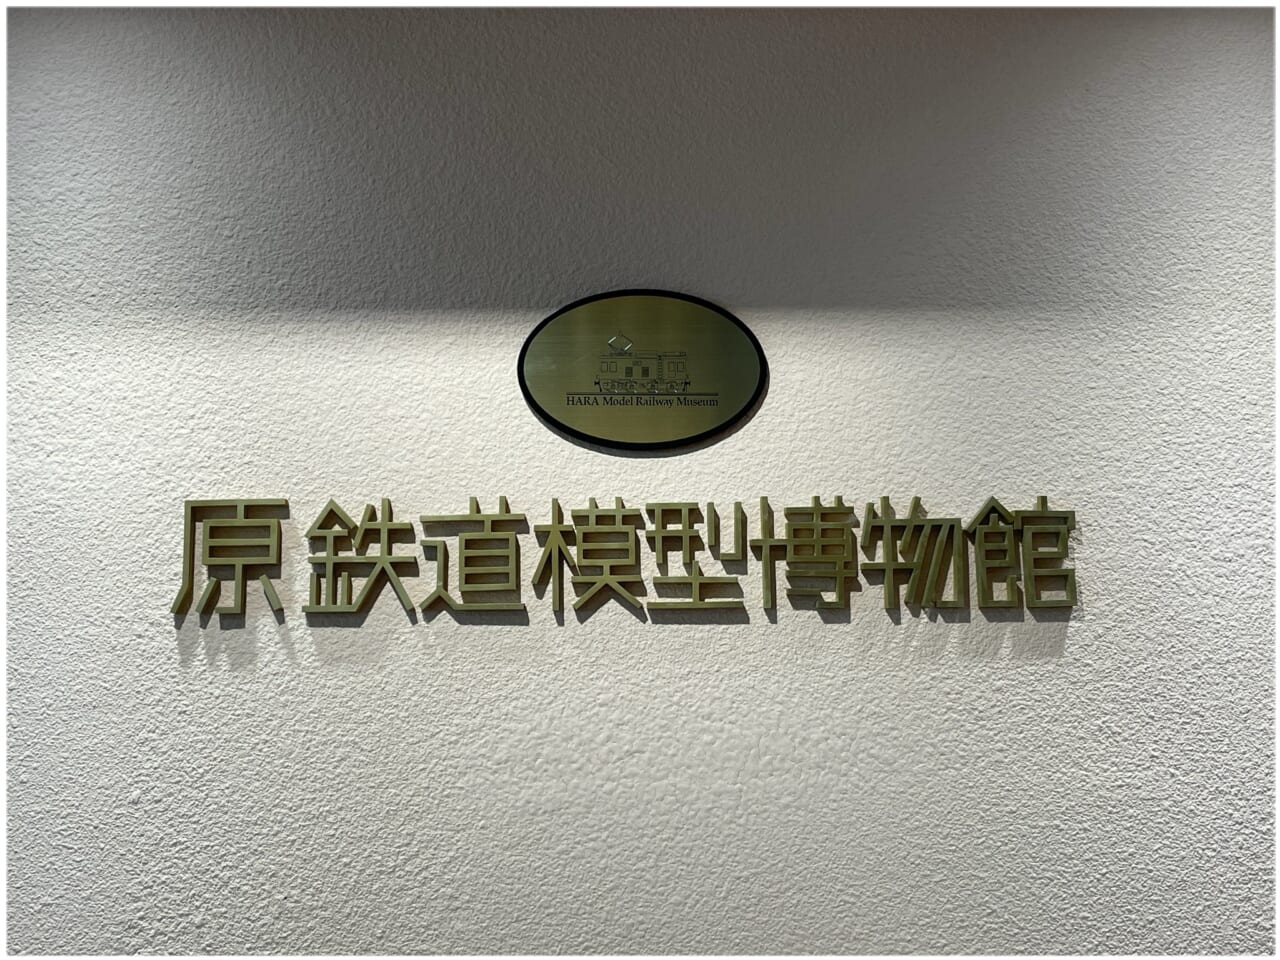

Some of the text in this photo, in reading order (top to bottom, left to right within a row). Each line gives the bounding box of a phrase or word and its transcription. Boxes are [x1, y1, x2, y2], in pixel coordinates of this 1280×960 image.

[566, 396, 719, 408] HARA Model Railway Museum
[172, 495, 1077, 620] 原鉄道模型博物館
